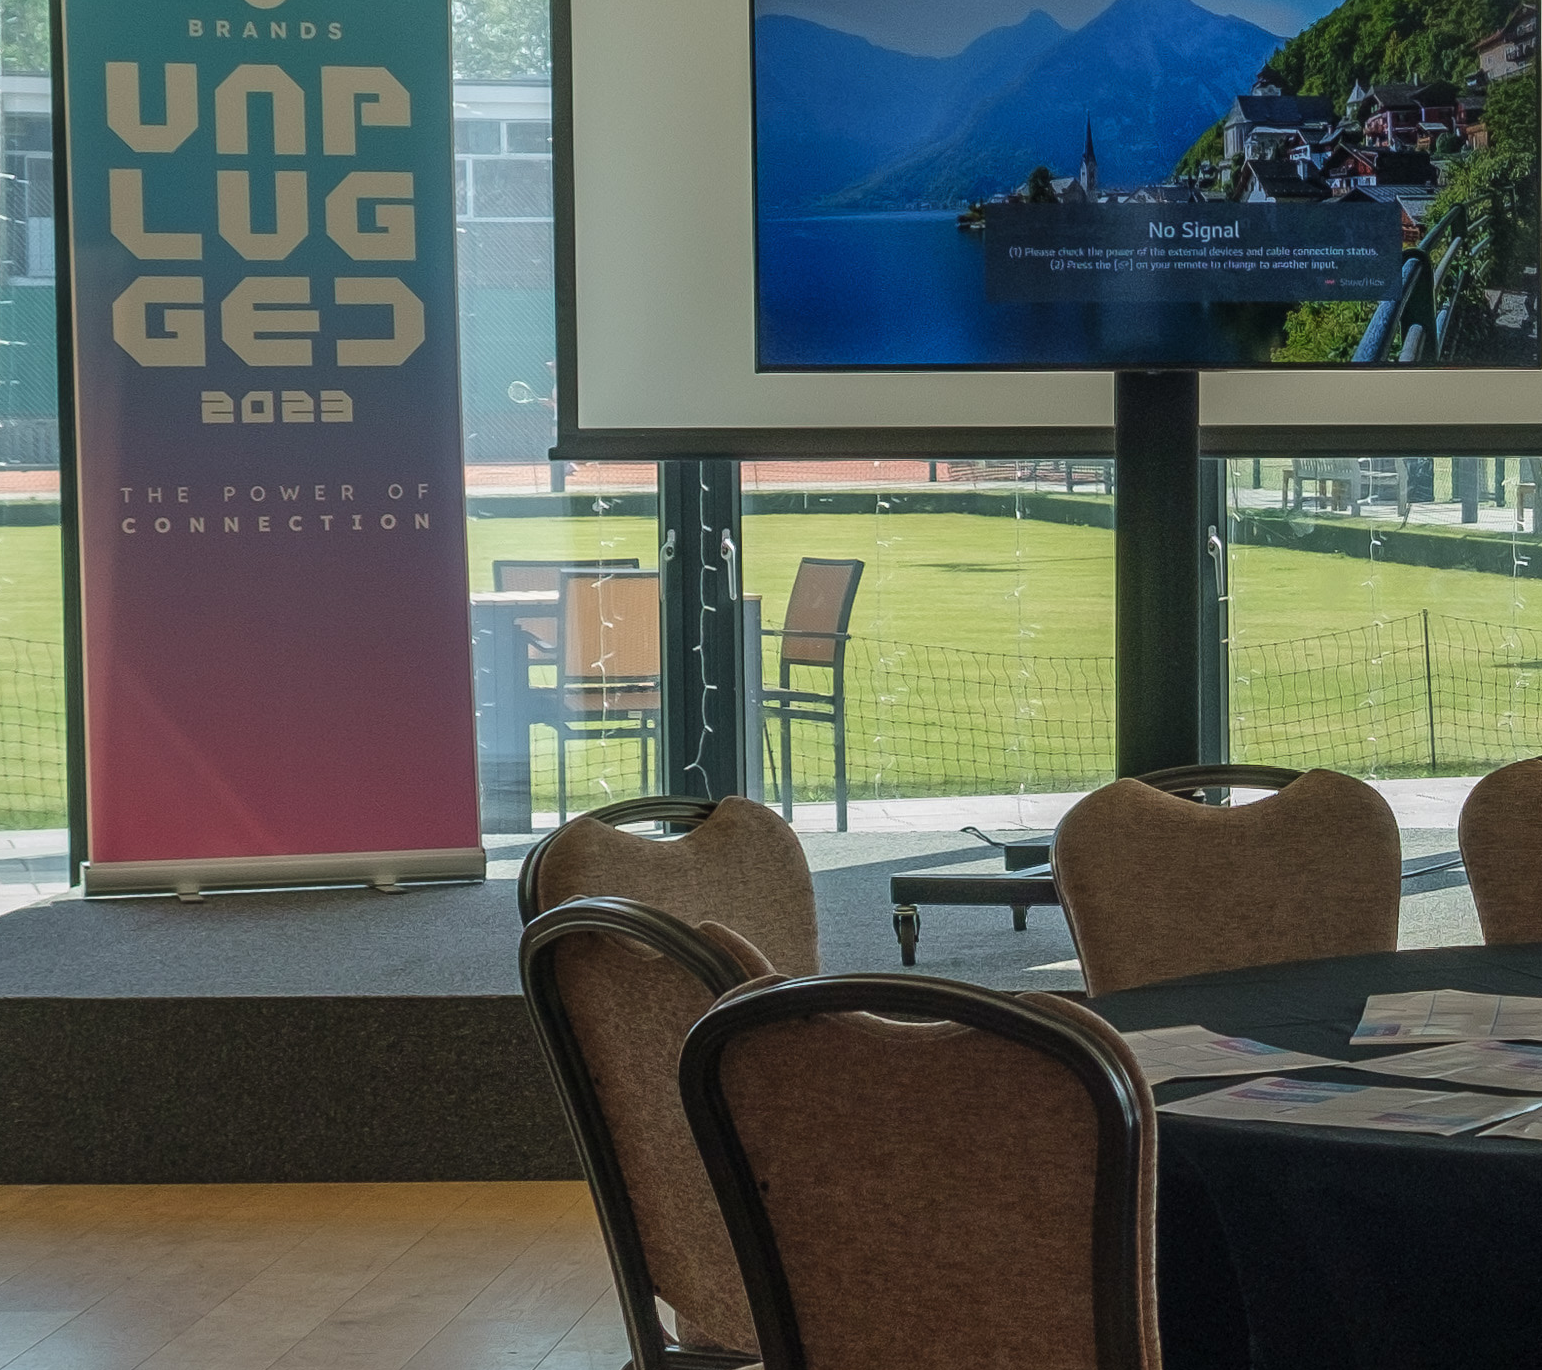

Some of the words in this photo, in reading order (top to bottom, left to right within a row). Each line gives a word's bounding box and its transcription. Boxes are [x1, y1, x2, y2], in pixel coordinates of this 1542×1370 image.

[188, 18, 343, 40] BRANDS
[105, 62, 411, 156] UNP
[108, 168, 416, 261] LUG
[1148, 221, 1176, 239] No
[1181, 220, 1240, 243] Signal
[1008, 246, 1023, 259] (1)
[1024, 247, 1056, 257] Please
[1058, 246, 1085, 257] check
[1087, 246, 1103, 257] the
[1105, 247, 1134, 259] power
[1150, 246, 1166, 257] the
[1167, 247, 1207, 257] external
[1208, 246, 1244, 257] devices
[1246, 246, 1263, 257] and
[1265, 246, 1291, 257] cable
[1292, 246, 1344, 257] connection
[1346, 246, 1379, 258] status.
[1066, 260, 1093, 270] Press
[1135, 262, 1148, 270] on
[1150, 261, 1171, 272] your
[1173, 260, 1208, 270] remote
[1259, 260, 1270, 270] to
[1272, 259, 1309, 270] another
[1311, 259, 1339, 271] input.
[112, 275, 426, 367] GED
[201, 390, 353, 423] 2023
[120, 486, 190, 504] THE
[223, 484, 355, 502] POWER
[387, 483, 429, 500] OF
[121, 513, 430, 535] CONNECTION
